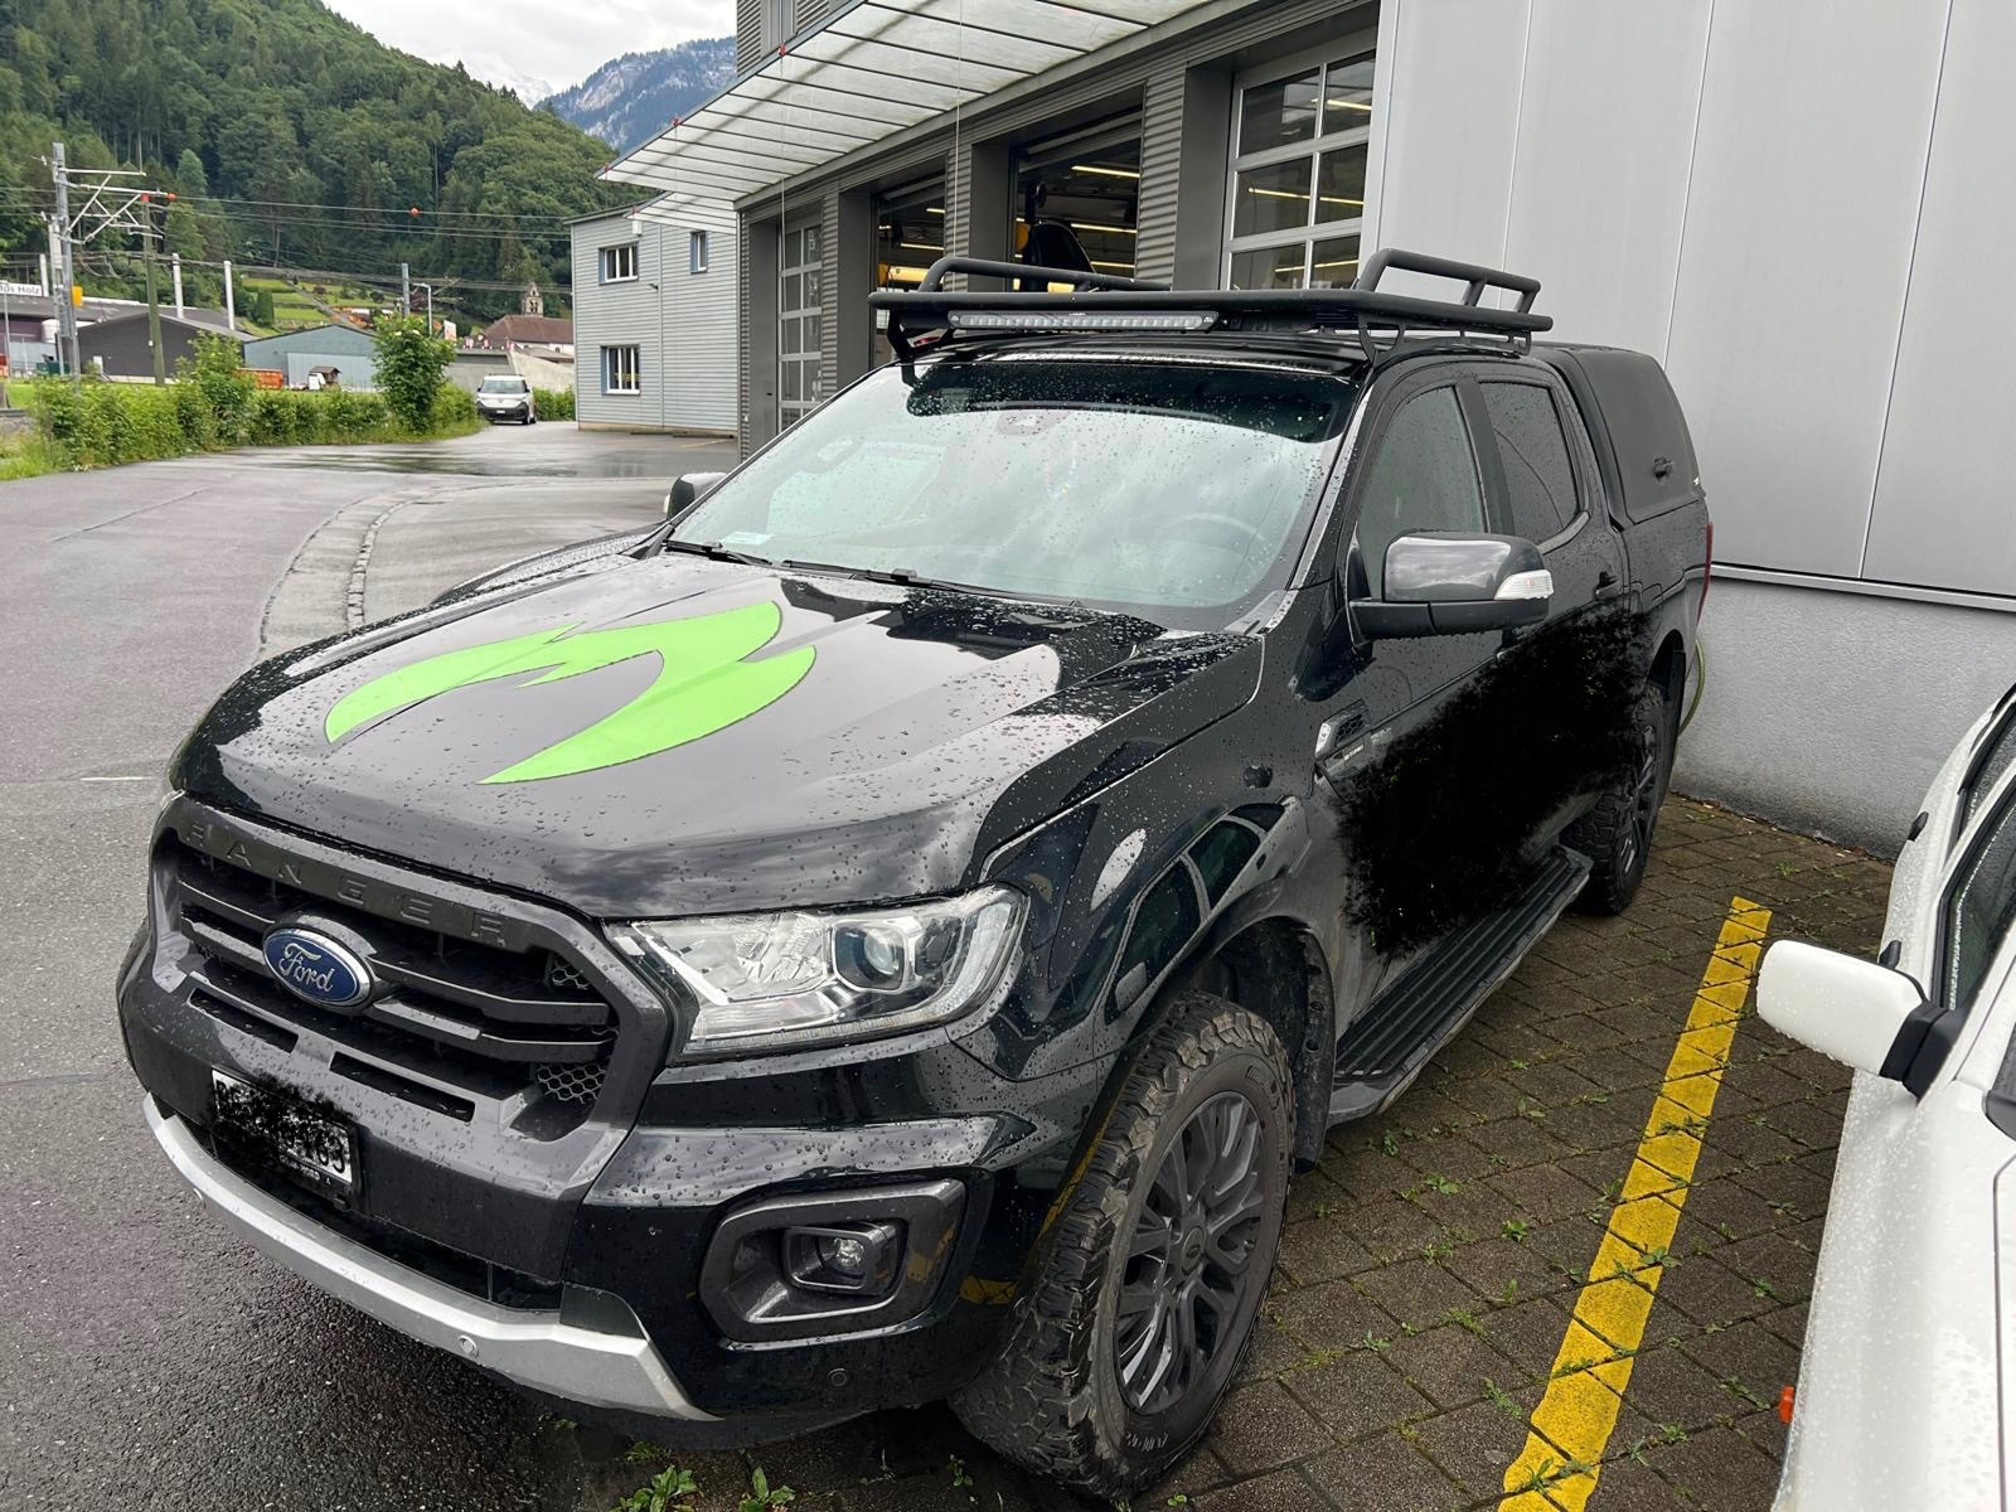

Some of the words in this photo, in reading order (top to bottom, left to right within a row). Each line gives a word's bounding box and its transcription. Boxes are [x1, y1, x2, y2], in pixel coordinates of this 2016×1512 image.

[18, 286, 39, 294] Holz
[186, 822, 506, 948] RANGER
[279, 942, 335, 992] Ford
